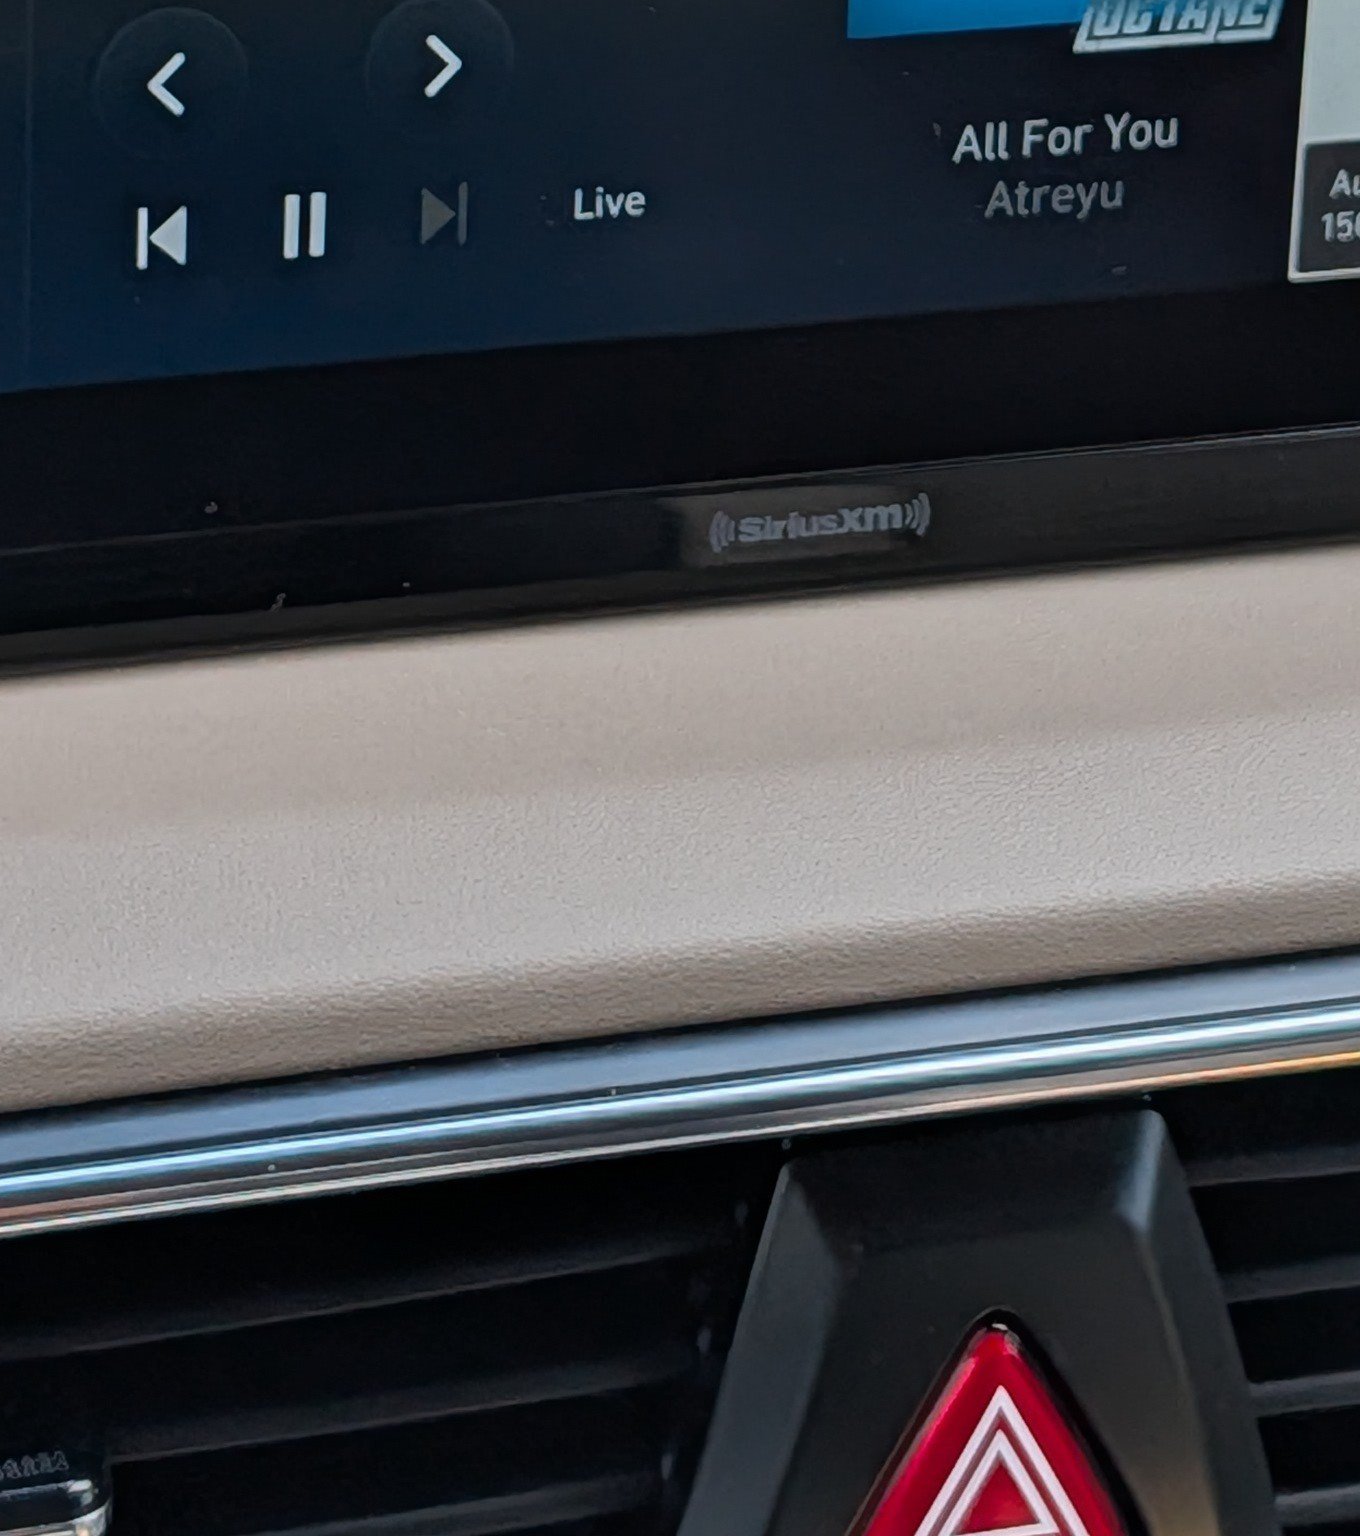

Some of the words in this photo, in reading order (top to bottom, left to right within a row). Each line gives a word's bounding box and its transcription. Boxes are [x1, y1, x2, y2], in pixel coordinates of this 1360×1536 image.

[952, 120, 1009, 164] All
[1021, 116, 1093, 158] For
[1104, 112, 1179, 151] You
[573, 186, 646, 221] Live
[984, 179, 1125, 220] Atreyu
